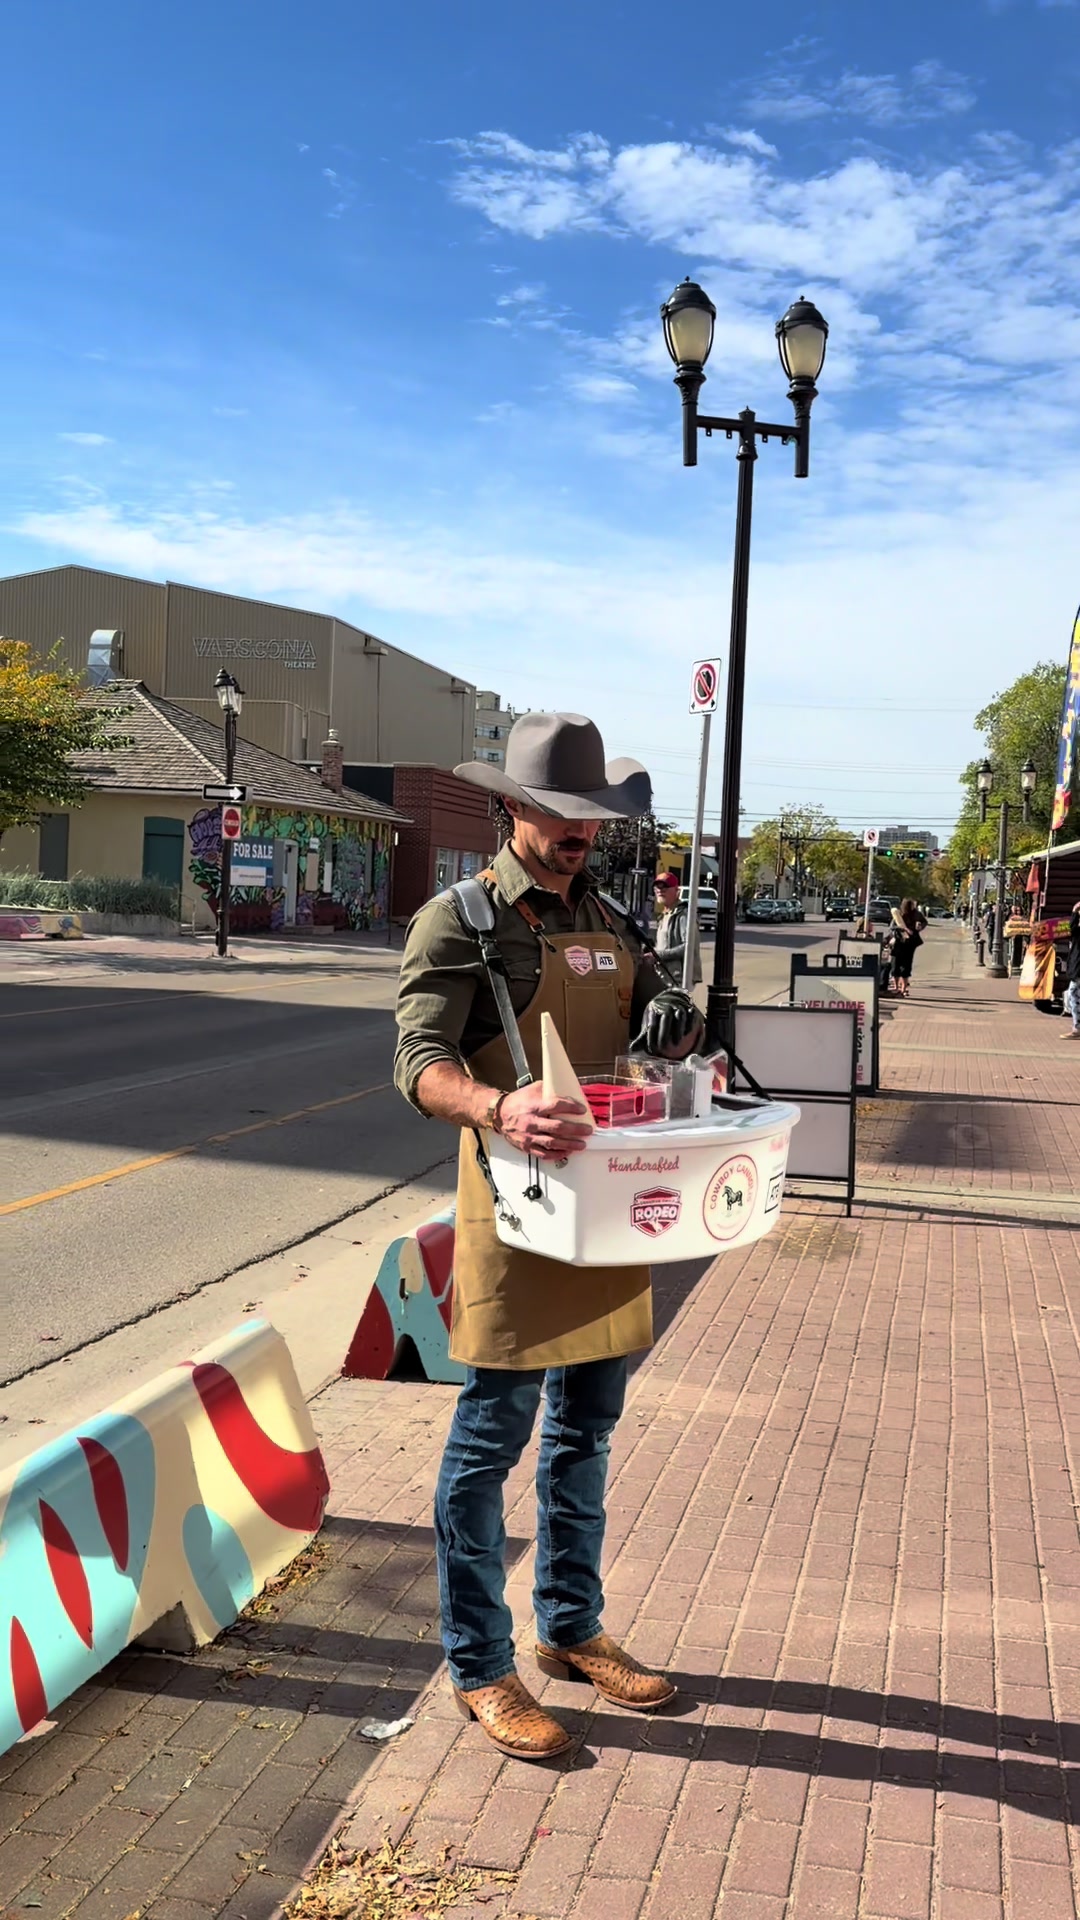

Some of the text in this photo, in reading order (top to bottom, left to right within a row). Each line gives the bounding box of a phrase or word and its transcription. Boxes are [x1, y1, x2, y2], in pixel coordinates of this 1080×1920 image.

[192, 637, 316, 659] VARSCONA
[283, 660, 316, 669] THEATRE
[233, 842, 273, 859] FOR SALE
[600, 956, 613, 965] ATB
[608, 1155, 680, 1173] Handcrafted
[710, 1166, 734, 1210] COWBOY
[635, 1206, 677, 1221] RODEO
